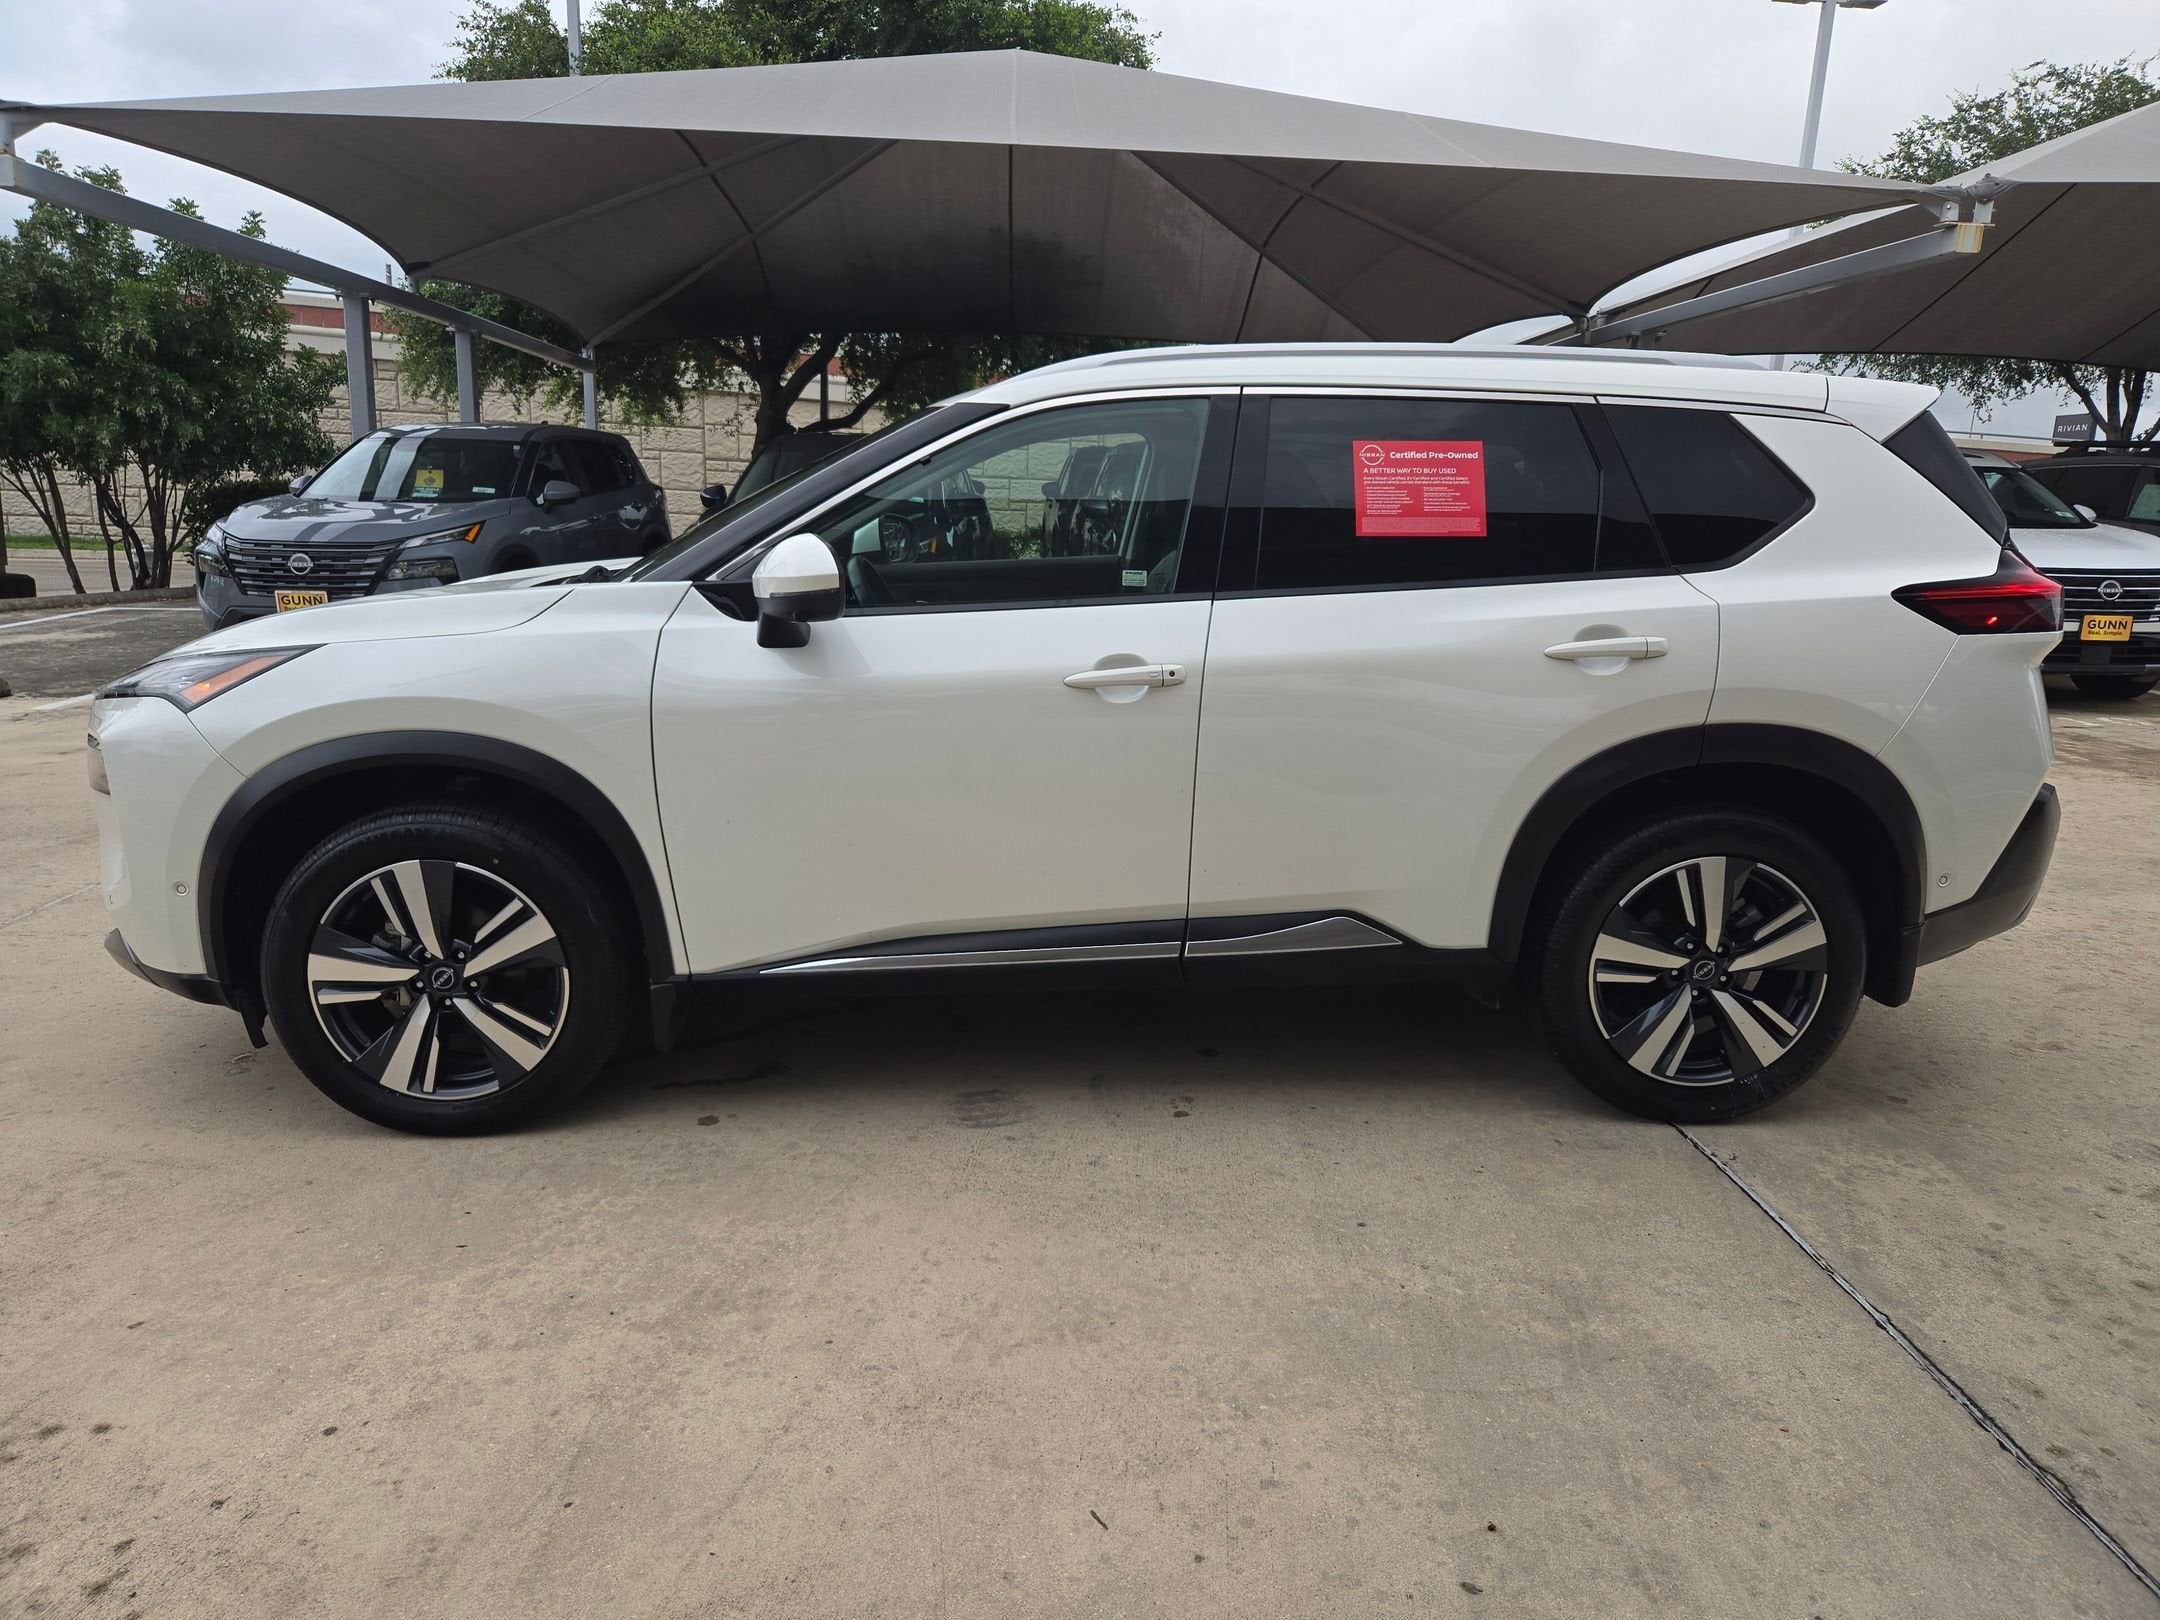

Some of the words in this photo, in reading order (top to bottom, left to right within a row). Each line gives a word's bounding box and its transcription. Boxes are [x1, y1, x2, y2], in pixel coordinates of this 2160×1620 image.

[2057, 423, 2089, 433] RIVIAN
[1390, 451, 1427, 459] Certified
[1429, 451, 1479, 459] Pre-Owned
[281, 595, 323, 606] GUNN
[2087, 619, 2128, 630] GUNN
